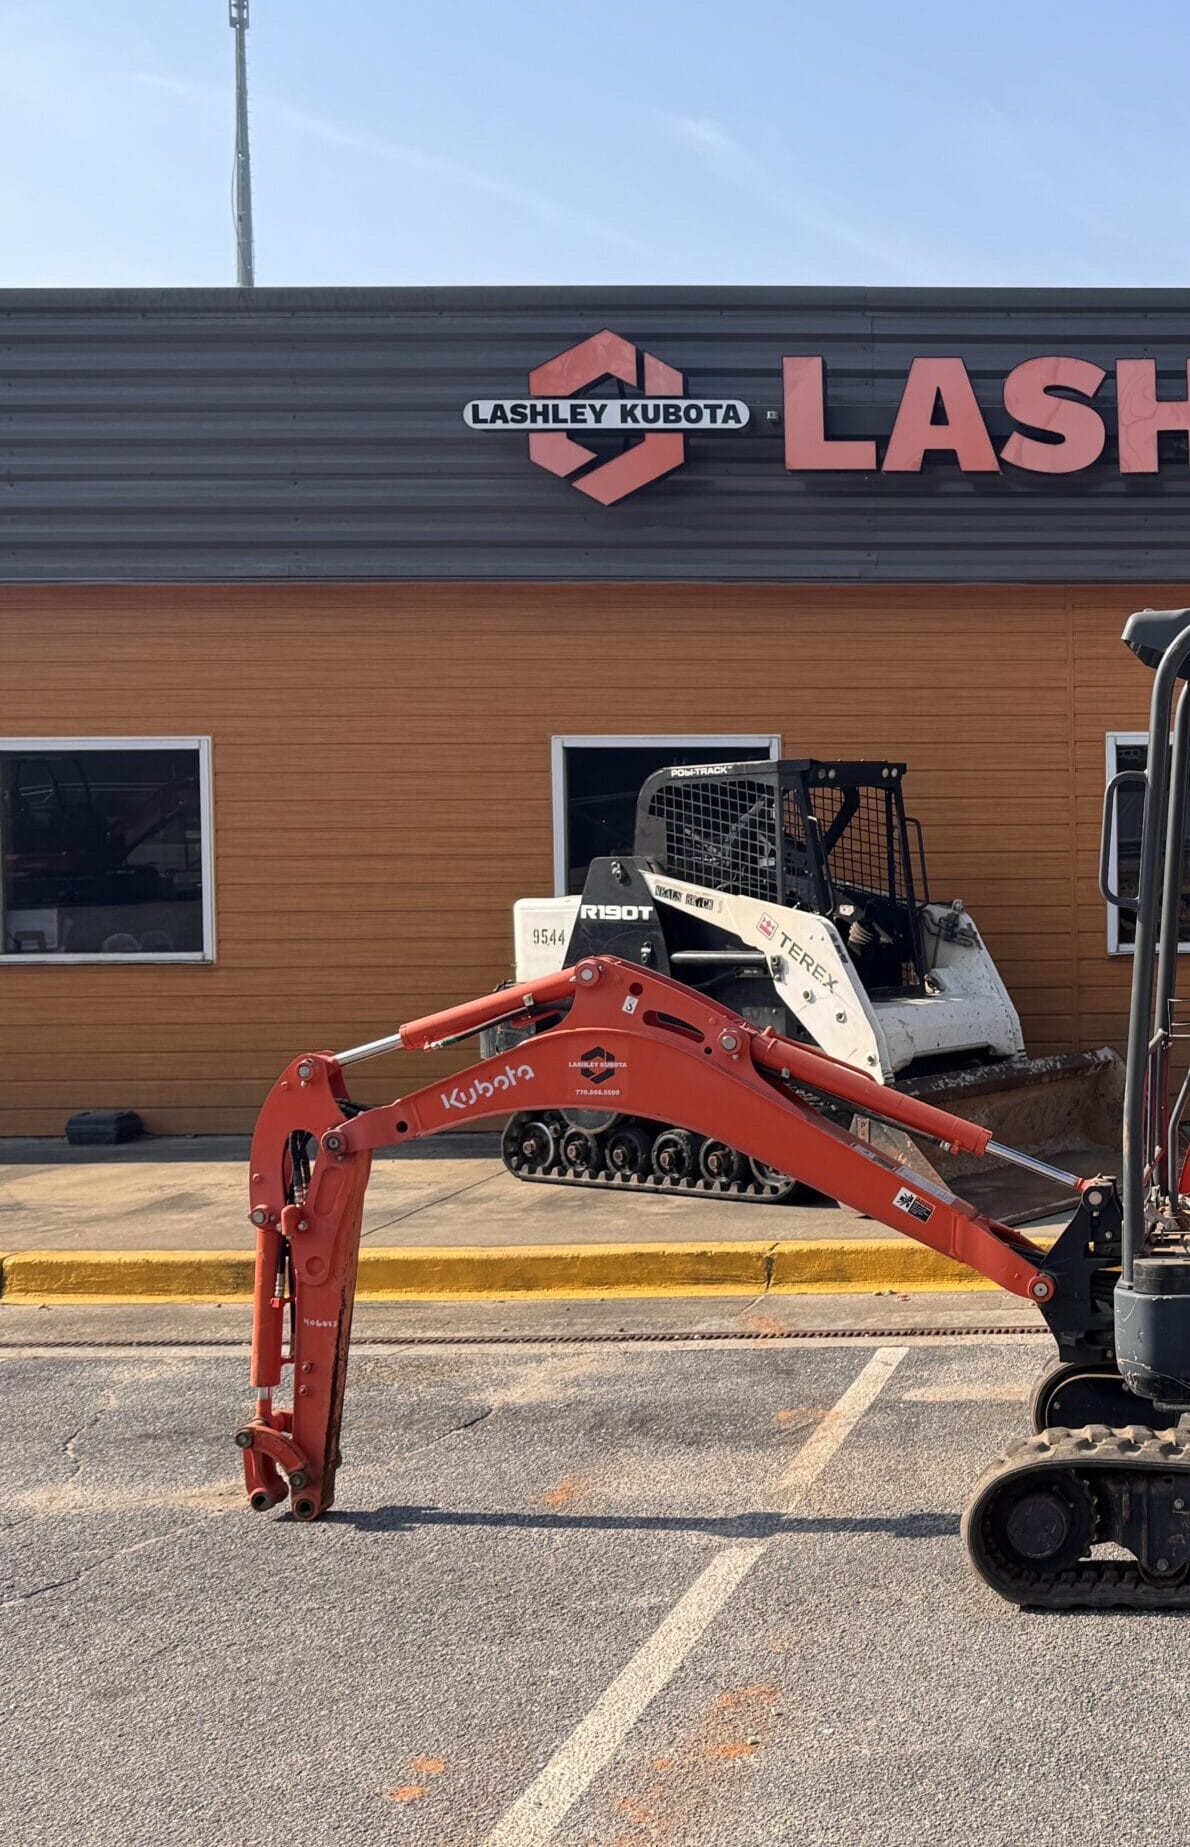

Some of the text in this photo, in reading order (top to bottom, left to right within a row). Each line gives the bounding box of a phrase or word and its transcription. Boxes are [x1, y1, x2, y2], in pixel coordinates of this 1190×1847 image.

[471, 403, 742, 424] LASHLEY KUBOTA
[580, 904, 654, 921] R190T
[533, 928, 565, 946] 9544
[779, 931, 839, 994] TEREX
[441, 1064, 535, 1109] Kubota
